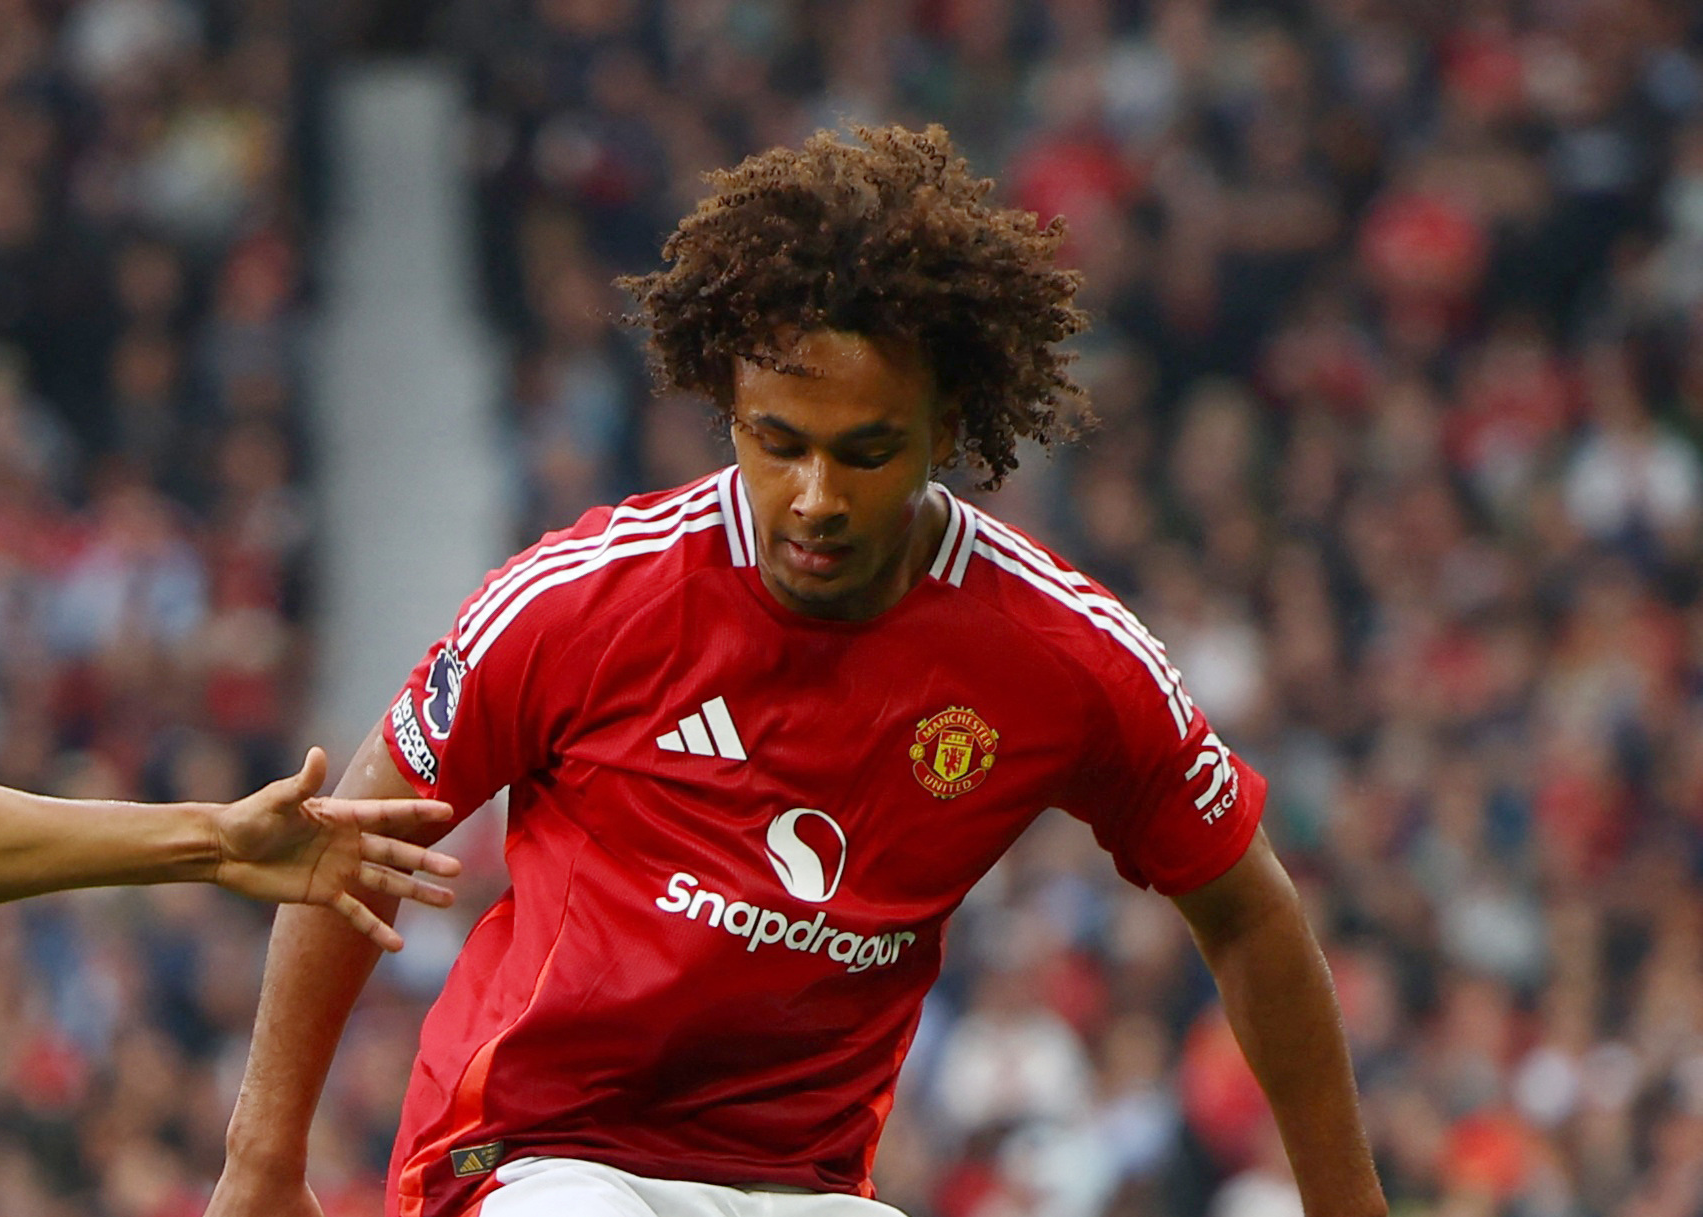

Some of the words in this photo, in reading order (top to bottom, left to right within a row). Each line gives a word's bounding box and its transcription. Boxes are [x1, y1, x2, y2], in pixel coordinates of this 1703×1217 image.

[401, 688, 413, 720] No
[405, 717, 436, 770] room
[922, 713, 993, 748] MANCHESTER
[395, 726, 436, 785] racism
[924, 774, 972, 793] UNITED
